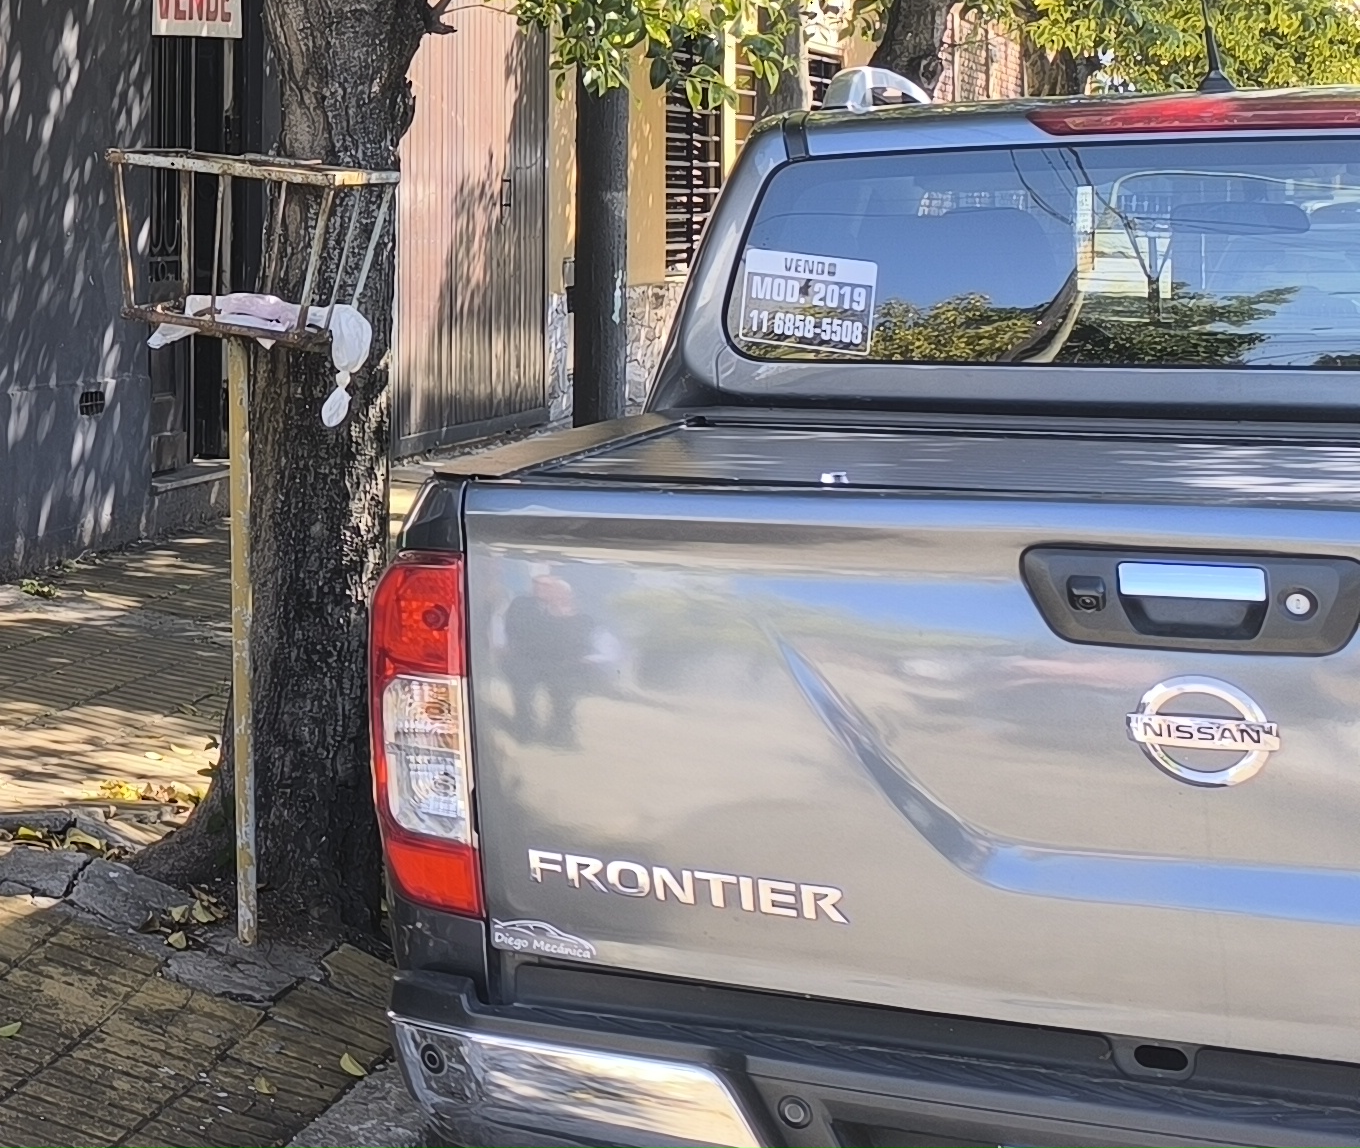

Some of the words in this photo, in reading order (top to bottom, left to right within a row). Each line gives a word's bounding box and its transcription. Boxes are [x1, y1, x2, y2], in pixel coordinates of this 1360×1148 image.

[784, 257, 837, 277] VENDO
[751, 275, 805, 304] MOD.
[812, 283, 867, 312] 2019
[749, 309, 769, 333] 11
[774, 312, 863, 345] 6858-5508
[1142, 721, 1261, 745] NISSAN
[527, 848, 851, 925] FRONTIER
[494, 931, 529, 951] Diego
[532, 939, 592, 959] Mecánica
